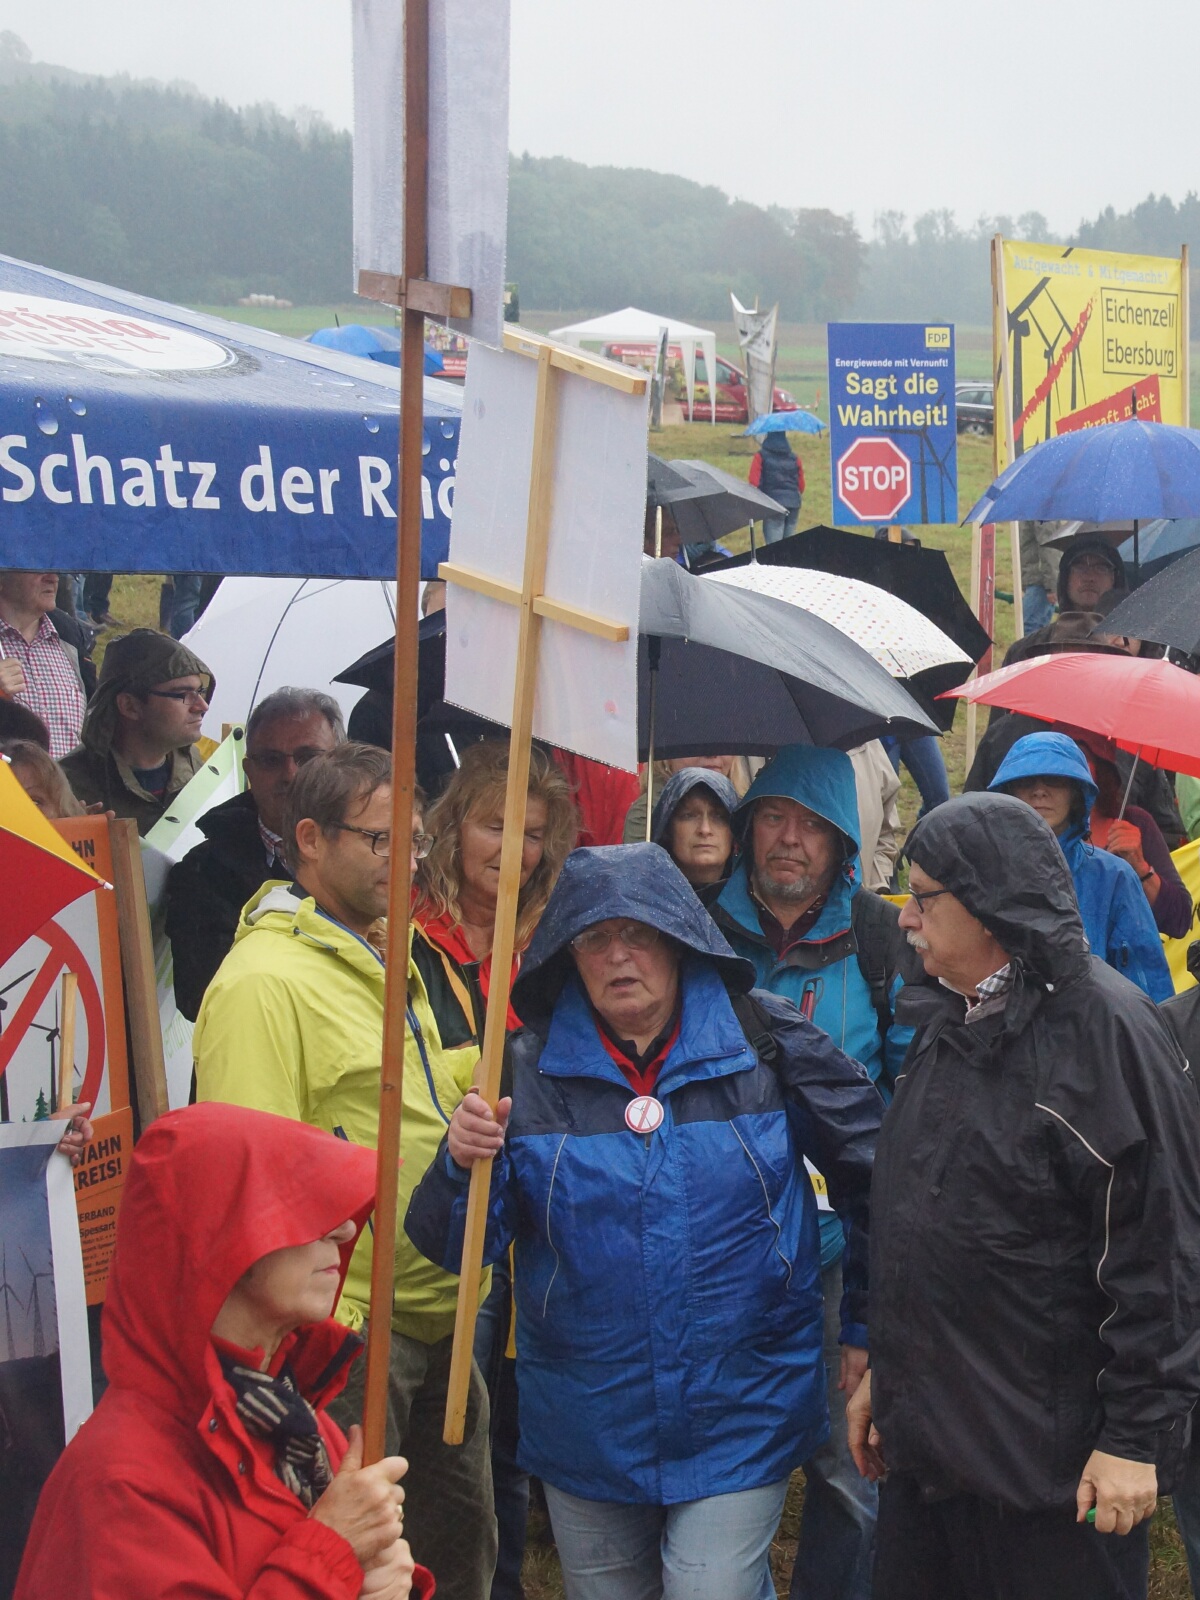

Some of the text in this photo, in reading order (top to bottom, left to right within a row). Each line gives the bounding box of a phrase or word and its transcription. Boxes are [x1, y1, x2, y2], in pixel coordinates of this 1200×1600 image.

[1105, 297, 1175, 328] Eichenzell
[927, 333, 948, 343] FDP
[835, 358, 948, 368] Energiewende mit Vernunft!
[1106, 337, 1174, 374] Ebersburg
[846, 372, 939, 401] Sagt die
[837, 404, 948, 427] Wahrheit!
[1124, 391, 1156, 418] ncht
[0, 434, 220, 509] Schatz
[240, 445, 340, 514] der
[844, 465, 905, 491] STOP
[73, 1158, 122, 1192] REIS!
[78, 1205, 115, 1223] ERBAND
